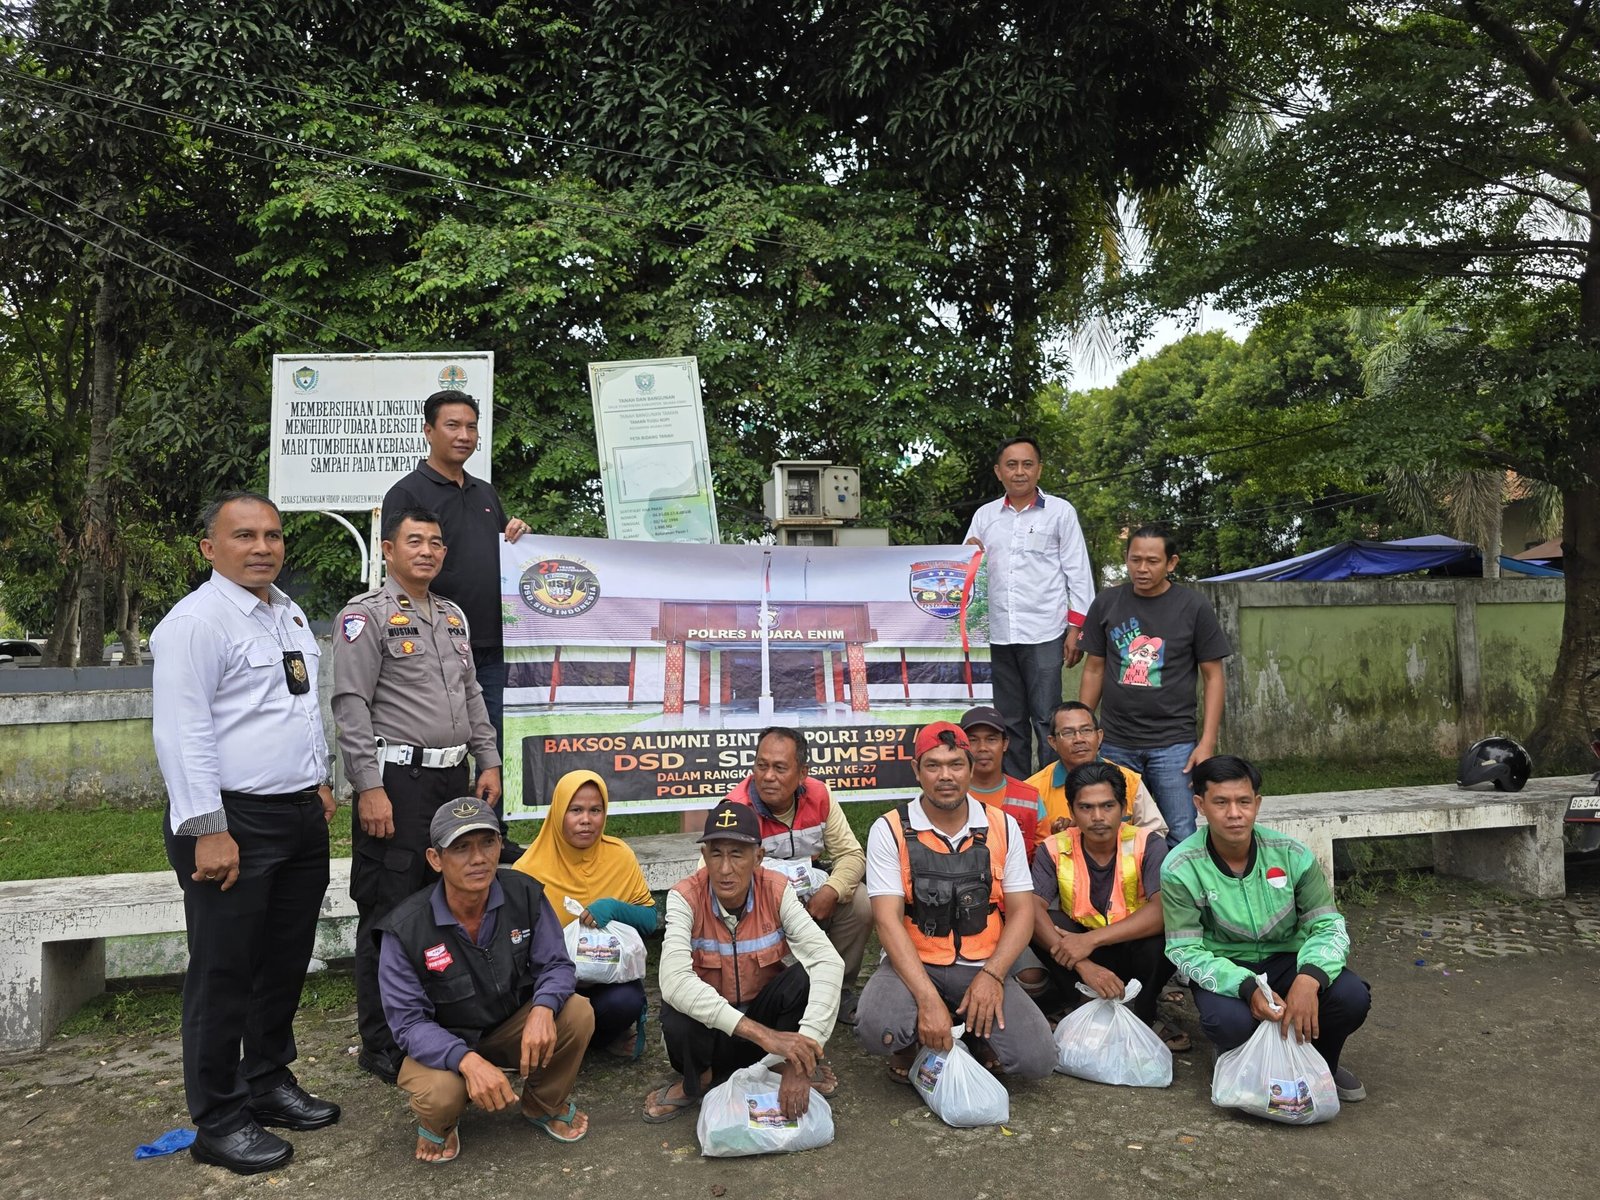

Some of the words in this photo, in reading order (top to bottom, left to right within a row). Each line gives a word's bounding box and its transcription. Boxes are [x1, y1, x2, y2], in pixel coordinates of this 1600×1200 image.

[290, 400, 374, 417] MEMBERSIHKAN
[285, 419, 342, 434] MENGHIRUP
[343, 418, 378, 434] UDARA
[380, 418, 417, 434] BERSIH
[281, 438, 308, 455] MARI
[310, 438, 374, 454] TUMBUHKAN
[376, 437, 428, 454] KEBIASAAN
[310, 457, 350, 472] SAMPAH
[352, 456, 376, 472] PADA
[378, 456, 428, 472] TEMPAT
[538, 561, 559, 574] 27
[555, 586, 596, 615] INDONESIA
[388, 626, 419, 637] MUSTAIN
[688, 629, 746, 639] POLRES
[808, 630, 844, 639] ENIM
[544, 736, 626, 753] BAKSOS
[632, 734, 710, 750] ALUMNI
[716, 733, 760, 747] BINT
[804, 730, 859, 744] POLRI
[864, 728, 906, 743] 1997
[614, 753, 685, 772] DSD
[718, 750, 756, 767] SD
[657, 771, 700, 782] DALAM
[844, 764, 877, 774] KE-27
[826, 777, 877, 788] ENIM
[1572, 800, 1582, 808] BG
[1169, 948, 1218, 992] Grab
